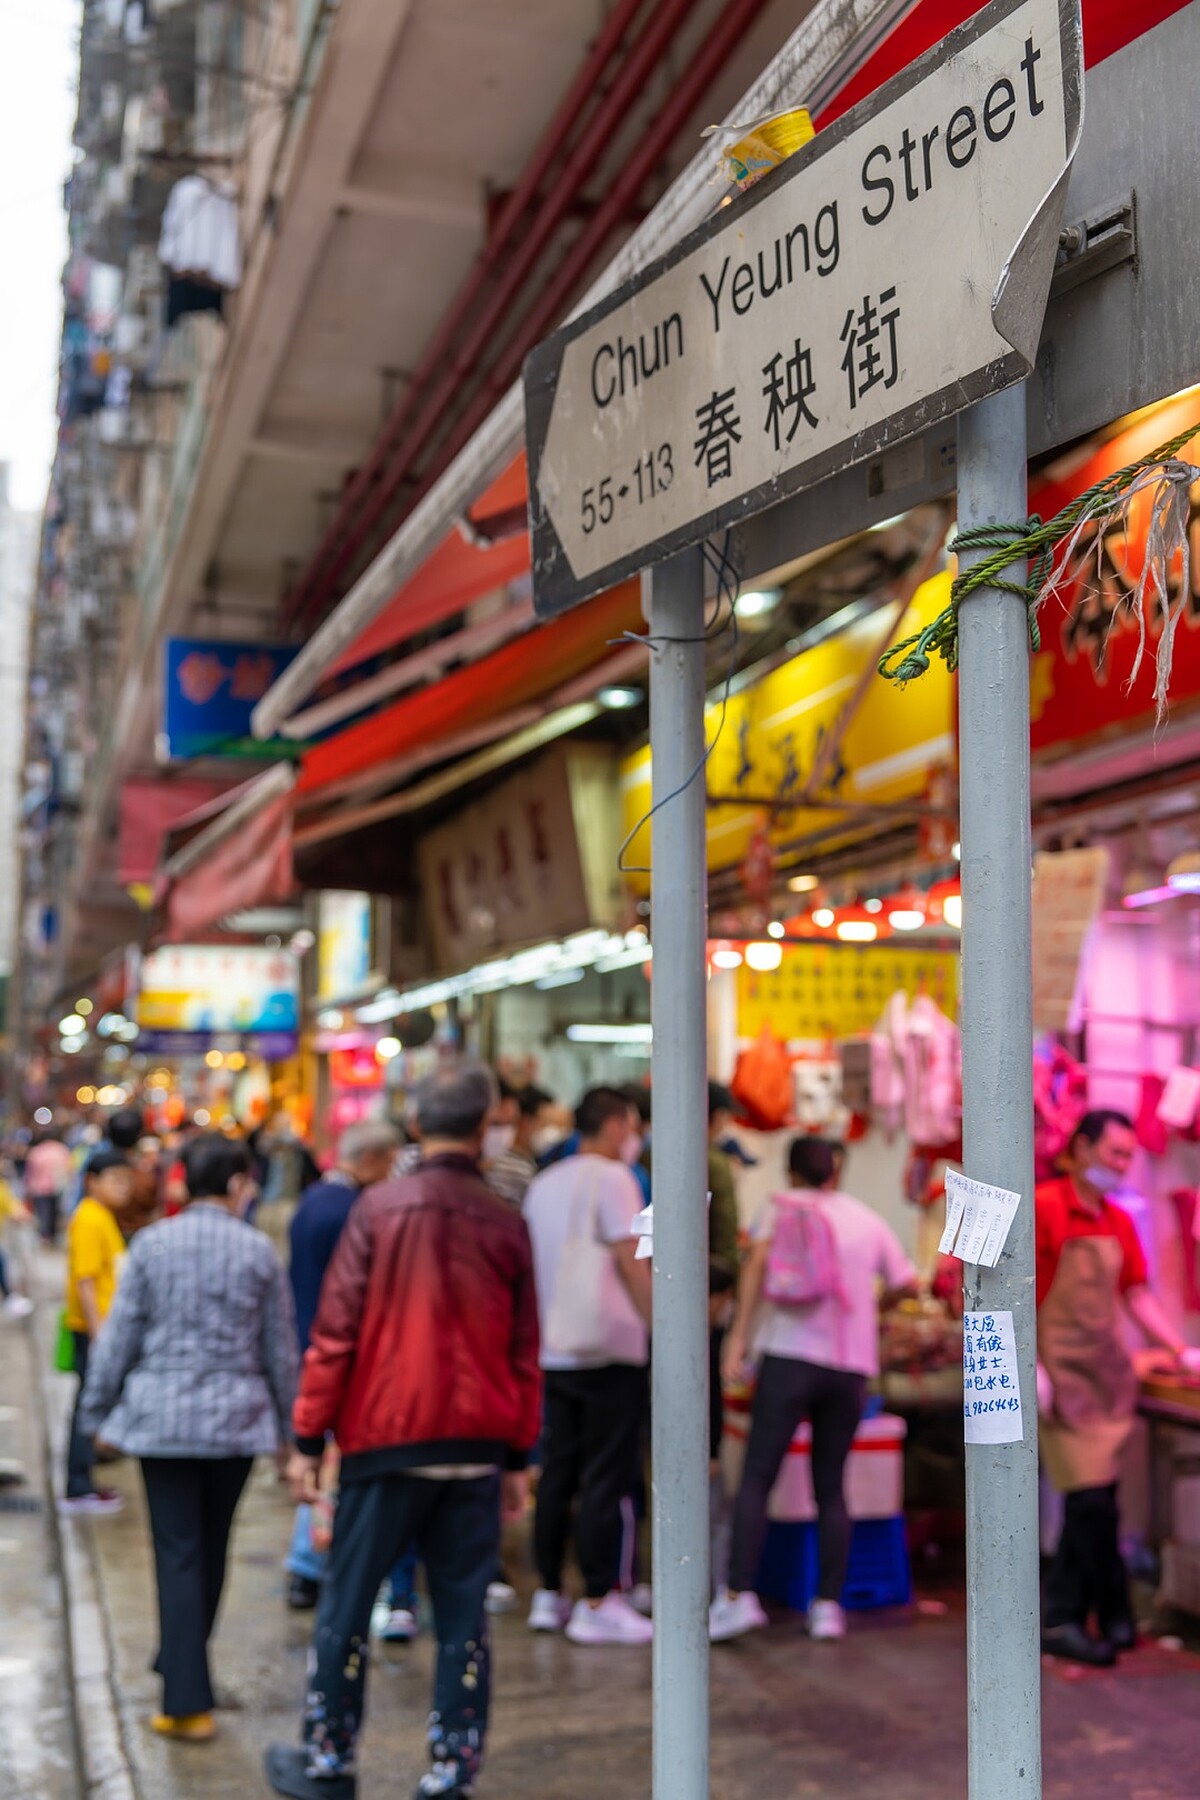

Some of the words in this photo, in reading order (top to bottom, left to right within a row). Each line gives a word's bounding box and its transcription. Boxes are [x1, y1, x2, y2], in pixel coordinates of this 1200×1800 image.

[591, 311, 684, 408] Chun
[700, 200, 838, 334] Yeung
[861, 36, 1045, 227] Street
[693, 286, 901, 489] 春秧街
